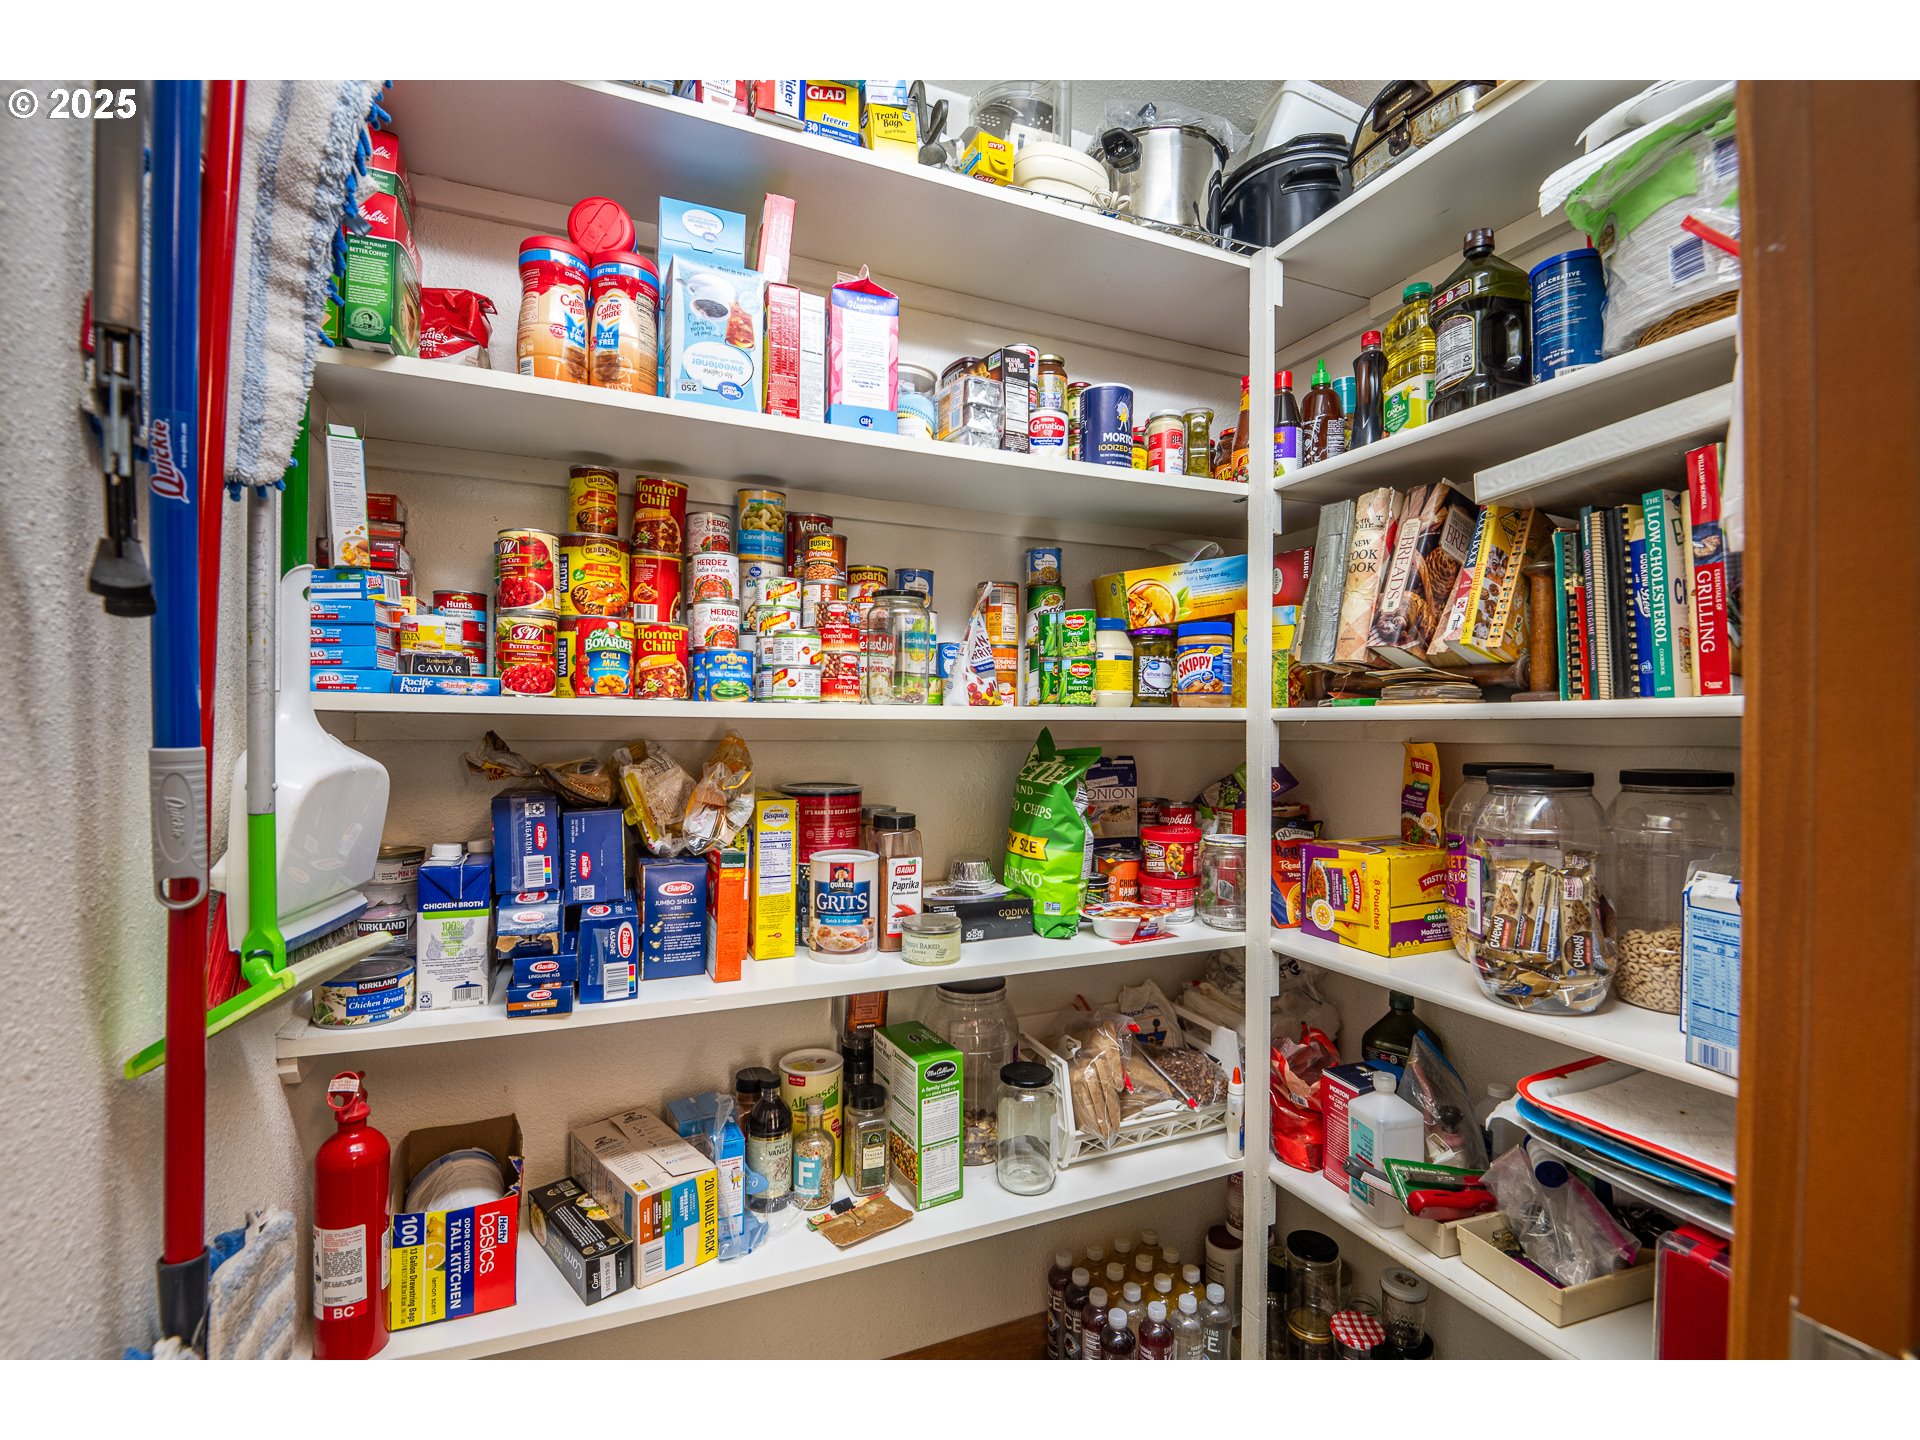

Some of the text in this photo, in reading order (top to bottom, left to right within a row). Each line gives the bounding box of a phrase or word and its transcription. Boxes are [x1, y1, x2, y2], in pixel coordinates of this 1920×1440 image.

[807, 87, 845, 100] GLAD
[822, 114, 849, 128] Freezer
[875, 112, 899, 120] Trash
[807, 122, 818, 132] 30
[884, 119, 903, 128] Bags
[989, 142, 1005, 151] GLAD
[975, 174, 995, 183] GLAD
[1537, 271, 1580, 289] GET CREATIVE
[597, 303, 621, 316] Coffee
[602, 310, 621, 320] mate
[691, 358, 744, 374] Sweetener
[1031, 420, 1064, 433] Carnation
[1103, 432, 1132, 442] MORTO
[1099, 444, 1128, 452] IODIZED
[636, 481, 678, 497] Hormel
[640, 493, 669, 507] Chili
[1645, 496, 1660, 505] THE
[800, 521, 818, 532] Van
[1467, 537, 1481, 566] BOOK
[696, 565, 709, 573] Salsa
[1386, 536, 1416, 600] BREADS
[1640, 553, 1649, 587] COOKING
[560, 563, 568, 591] VALUE
[851, 572, 887, 585] Rosarita
[1473, 561, 1485, 591] family
[1648, 512, 1667, 648] LOW-CHOLESTEROL
[1713, 569, 1722, 611] ESSENTIALS OF
[711, 608, 738, 616] HERDEZ
[1697, 570, 1715, 653] GRILLING
[513, 627, 542, 639] S&W
[638, 629, 682, 640] Hormel
[643, 640, 675, 652] Chili
[558, 647, 567, 676] VALUE
[601, 652, 620, 660] CHILI
[715, 653, 747, 665] ORTEGA
[418, 665, 462, 674] CAVIAR
[602, 659, 619, 667] MAC
[1178, 656, 1211, 678] SKIPPY
[401, 677, 434, 686] Pacific
[400, 685, 425, 693] Pearl
[1415, 761, 1430, 771] BITE
[763, 812, 789, 820] Bisquick
[1024, 802, 1052, 819] CHIPS
[525, 820, 533, 855] RIGATONI
[537, 825, 545, 849] Barilla
[569, 850, 577, 883] FARFALLE
[896, 866, 915, 874] BADIA
[892, 881, 919, 891] Paprika
[1422, 874, 1443, 886] TASTY
[666, 883, 691, 894] Barilla
[816, 893, 867, 911] GRITS
[998, 908, 1030, 917] GODIVA
[359, 920, 405, 931] KIRKLAND
[441, 921, 464, 931] 100%
[1421, 927, 1442, 936] Madras
[621, 929, 629, 955] Barilla
[1574, 935, 1584, 968] CHEWY
[359, 978, 398, 990] KIRKLAND
[349, 993, 404, 1010] Chicken Breast
[926, 1084, 940, 1093] family
[941, 1079, 960, 1090] tradition
[1329, 1084, 1349, 1099] MORTON
[768, 1143, 792, 1156] VANILLA
[798, 1161, 815, 1186] F
[704, 1178, 715, 1255] 20 VALUE PACK
[401, 1216, 418, 1245] 100
[498, 1216, 508, 1243] Hefty
[412, 1248, 418, 1256] 13
[464, 1241, 472, 1274] CONTROL
[450, 1219, 462, 1310] TALL KITCHEN
[333, 1306, 355, 1319] BC
[408, 1308, 417, 1322] Bags
